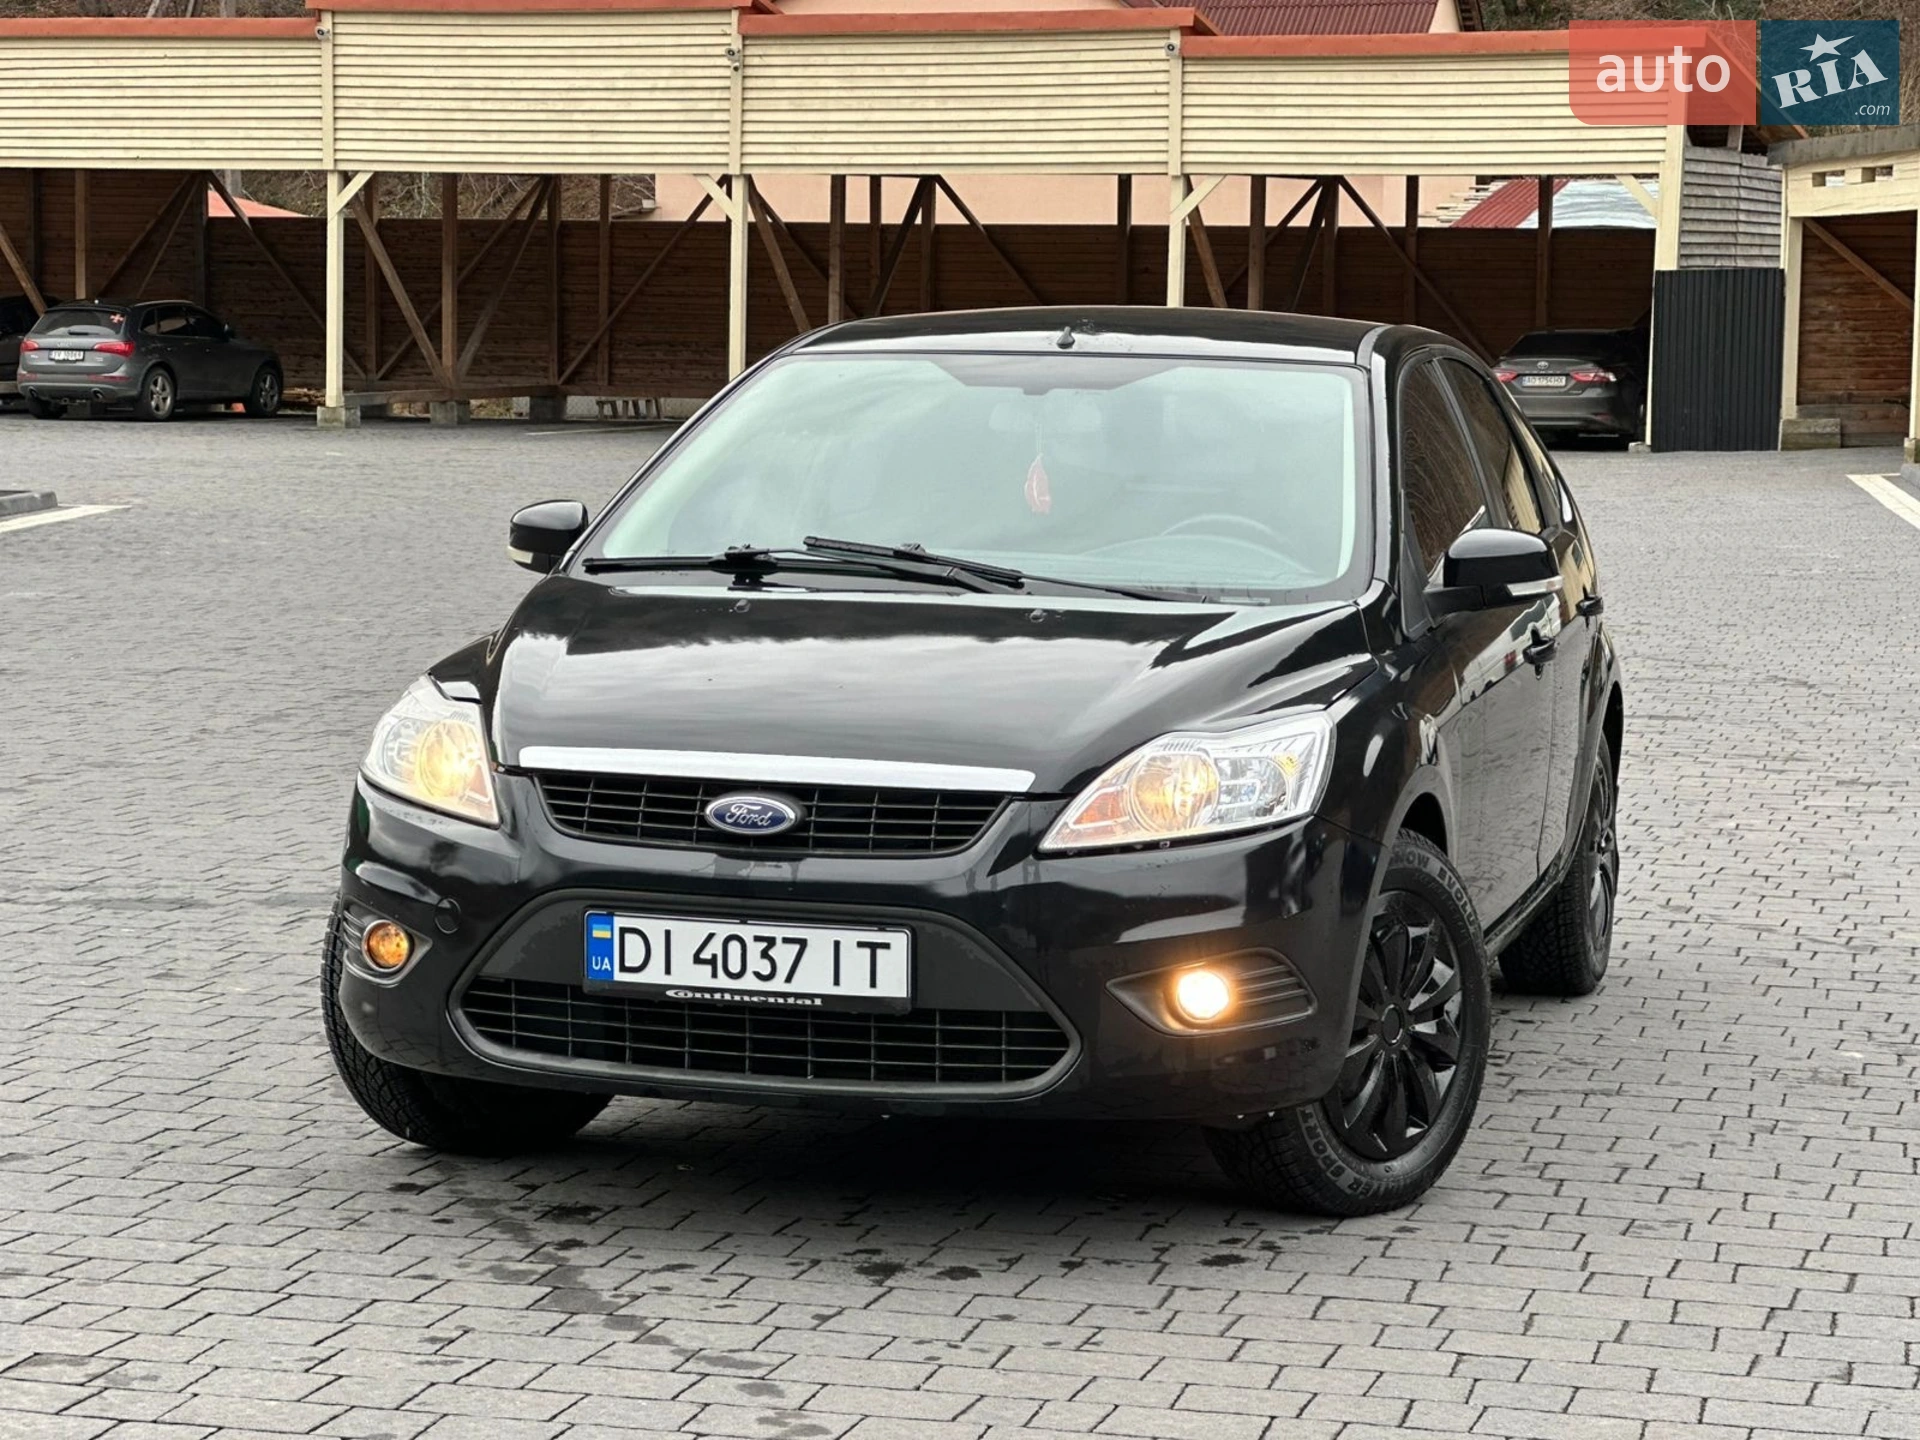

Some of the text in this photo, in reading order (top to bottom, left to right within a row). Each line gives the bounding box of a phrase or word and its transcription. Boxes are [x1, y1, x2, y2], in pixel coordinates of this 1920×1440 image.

[725, 803, 773, 826] Ford
[592, 956, 611, 971] UA
[618, 926, 892, 989] DI 4037 IT
